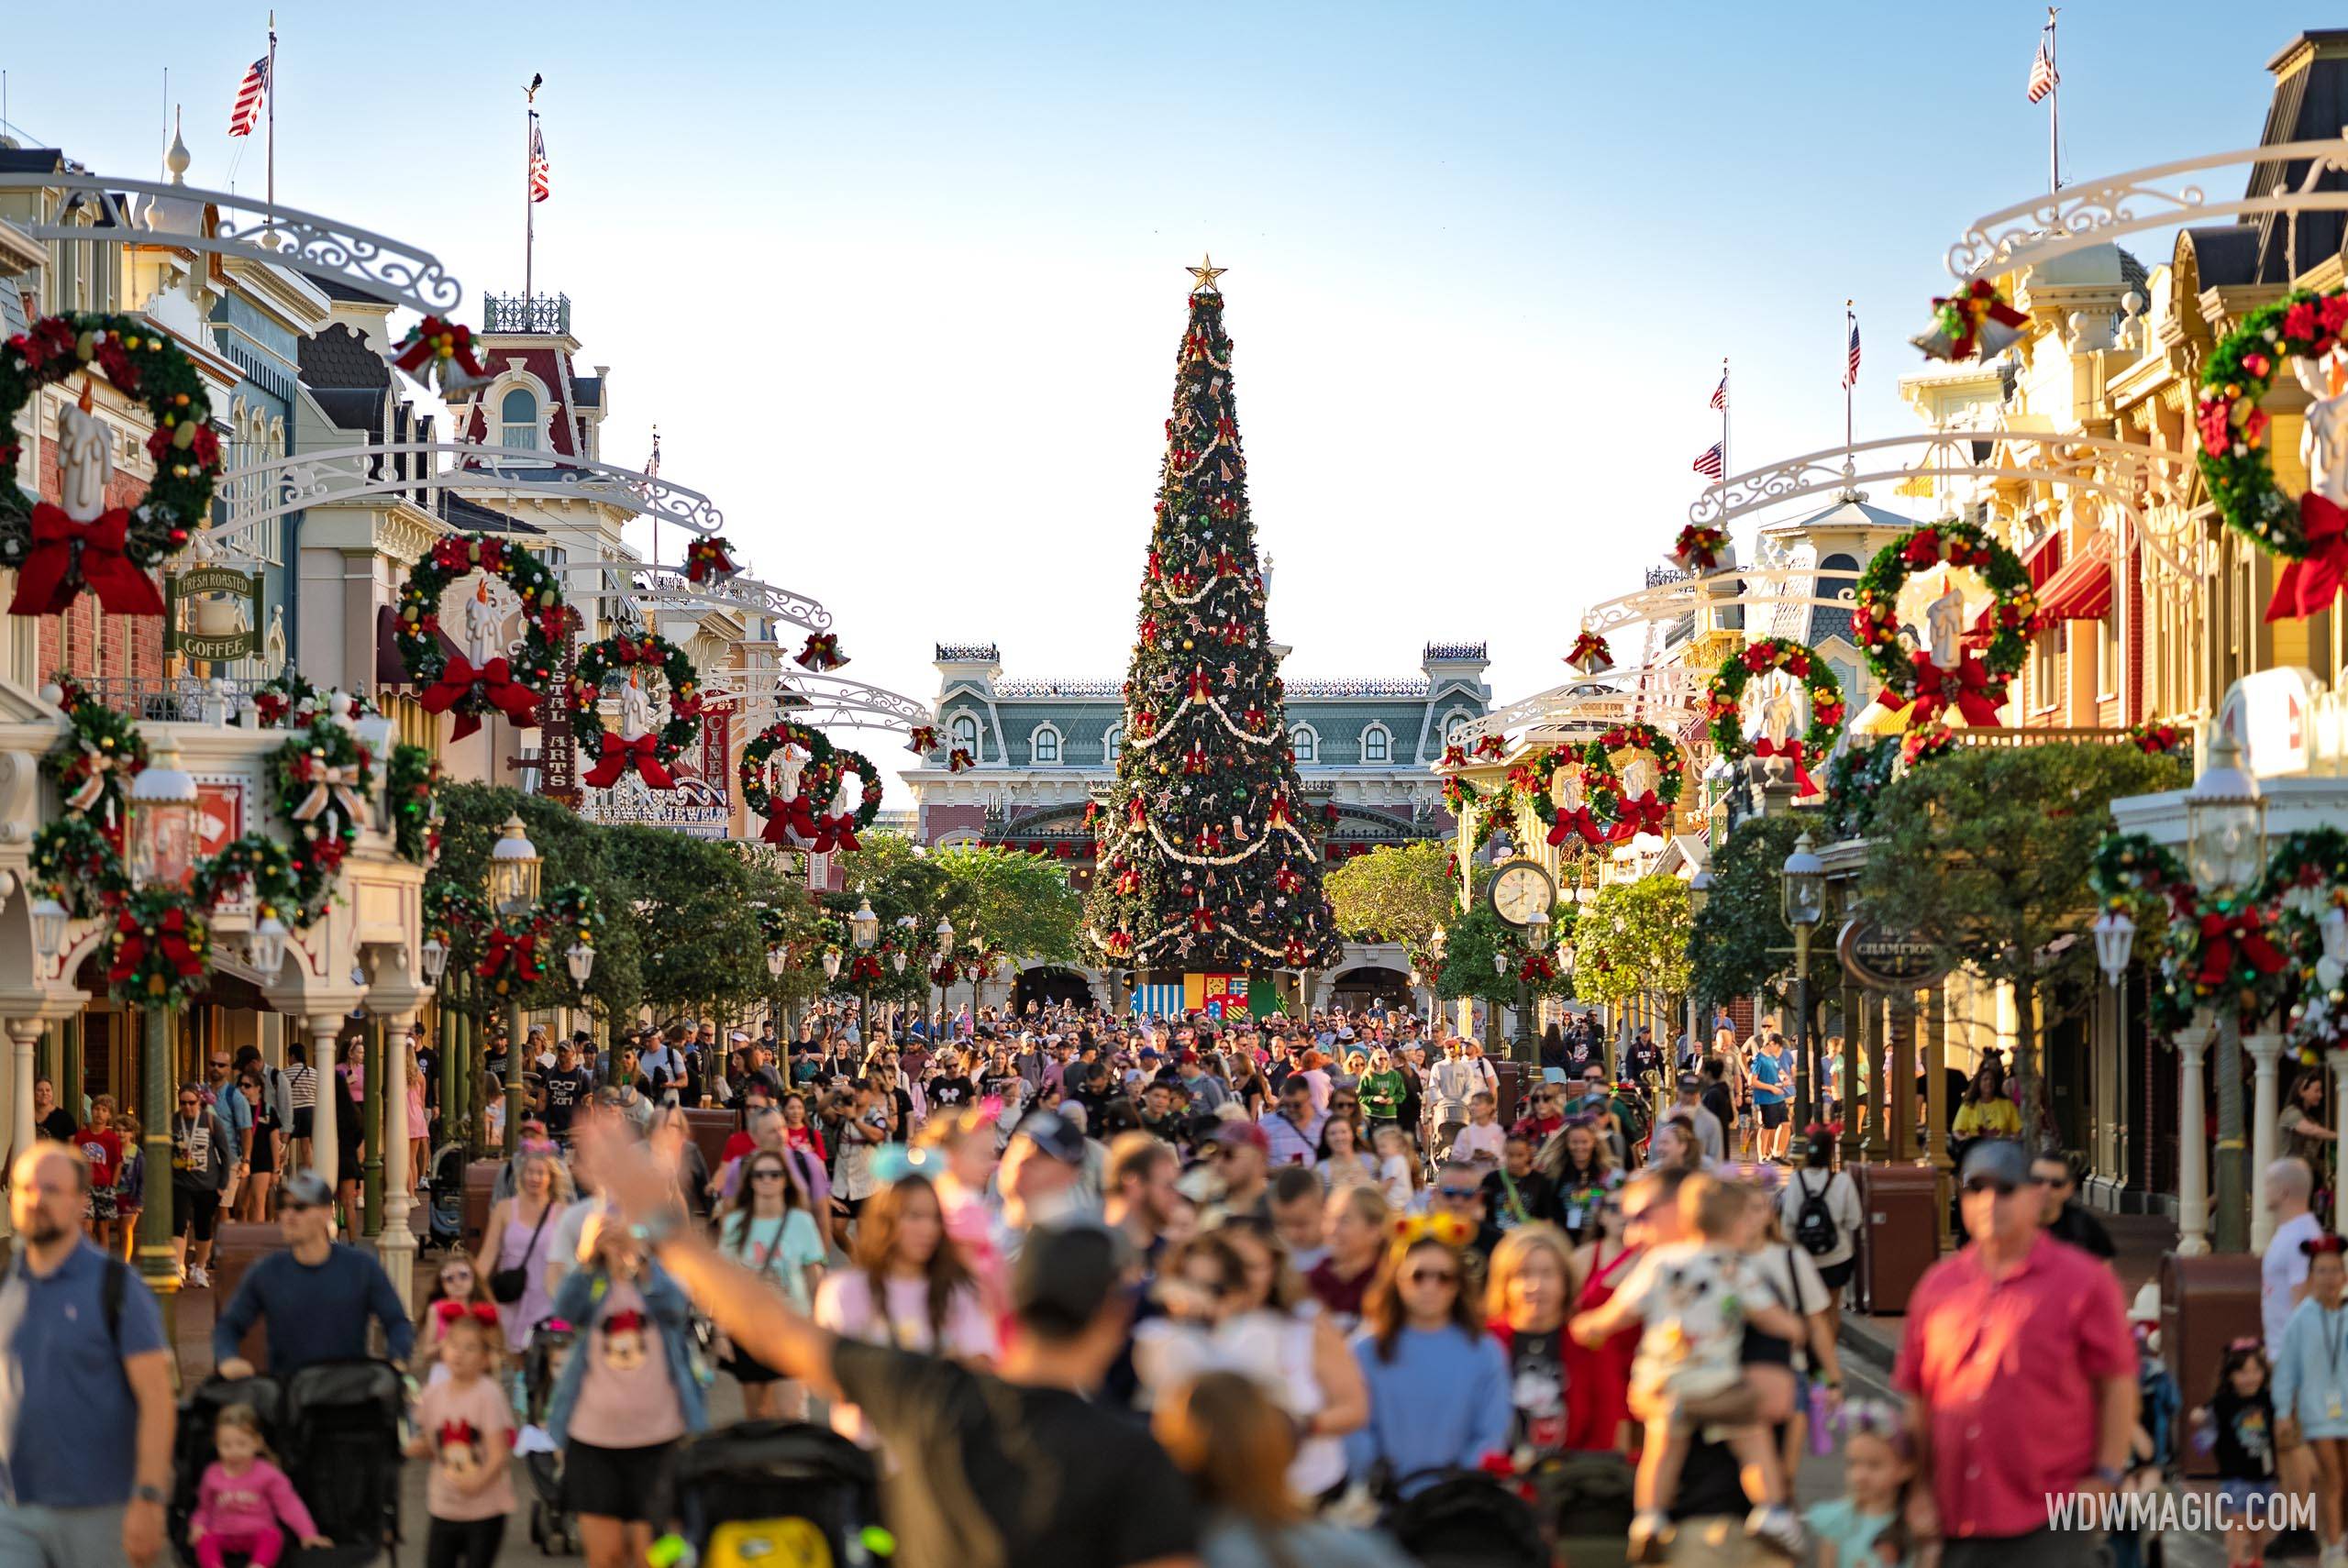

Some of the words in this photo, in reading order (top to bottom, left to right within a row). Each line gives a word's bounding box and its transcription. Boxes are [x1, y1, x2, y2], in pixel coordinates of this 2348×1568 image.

[183, 575, 208, 592] FRESH
[210, 573, 248, 592] ROASTED
[184, 637, 244, 657] COFFEE
[549, 657, 567, 723] YSTAL
[549, 735, 568, 788] ARTS
[707, 715, 724, 790] CINEM
